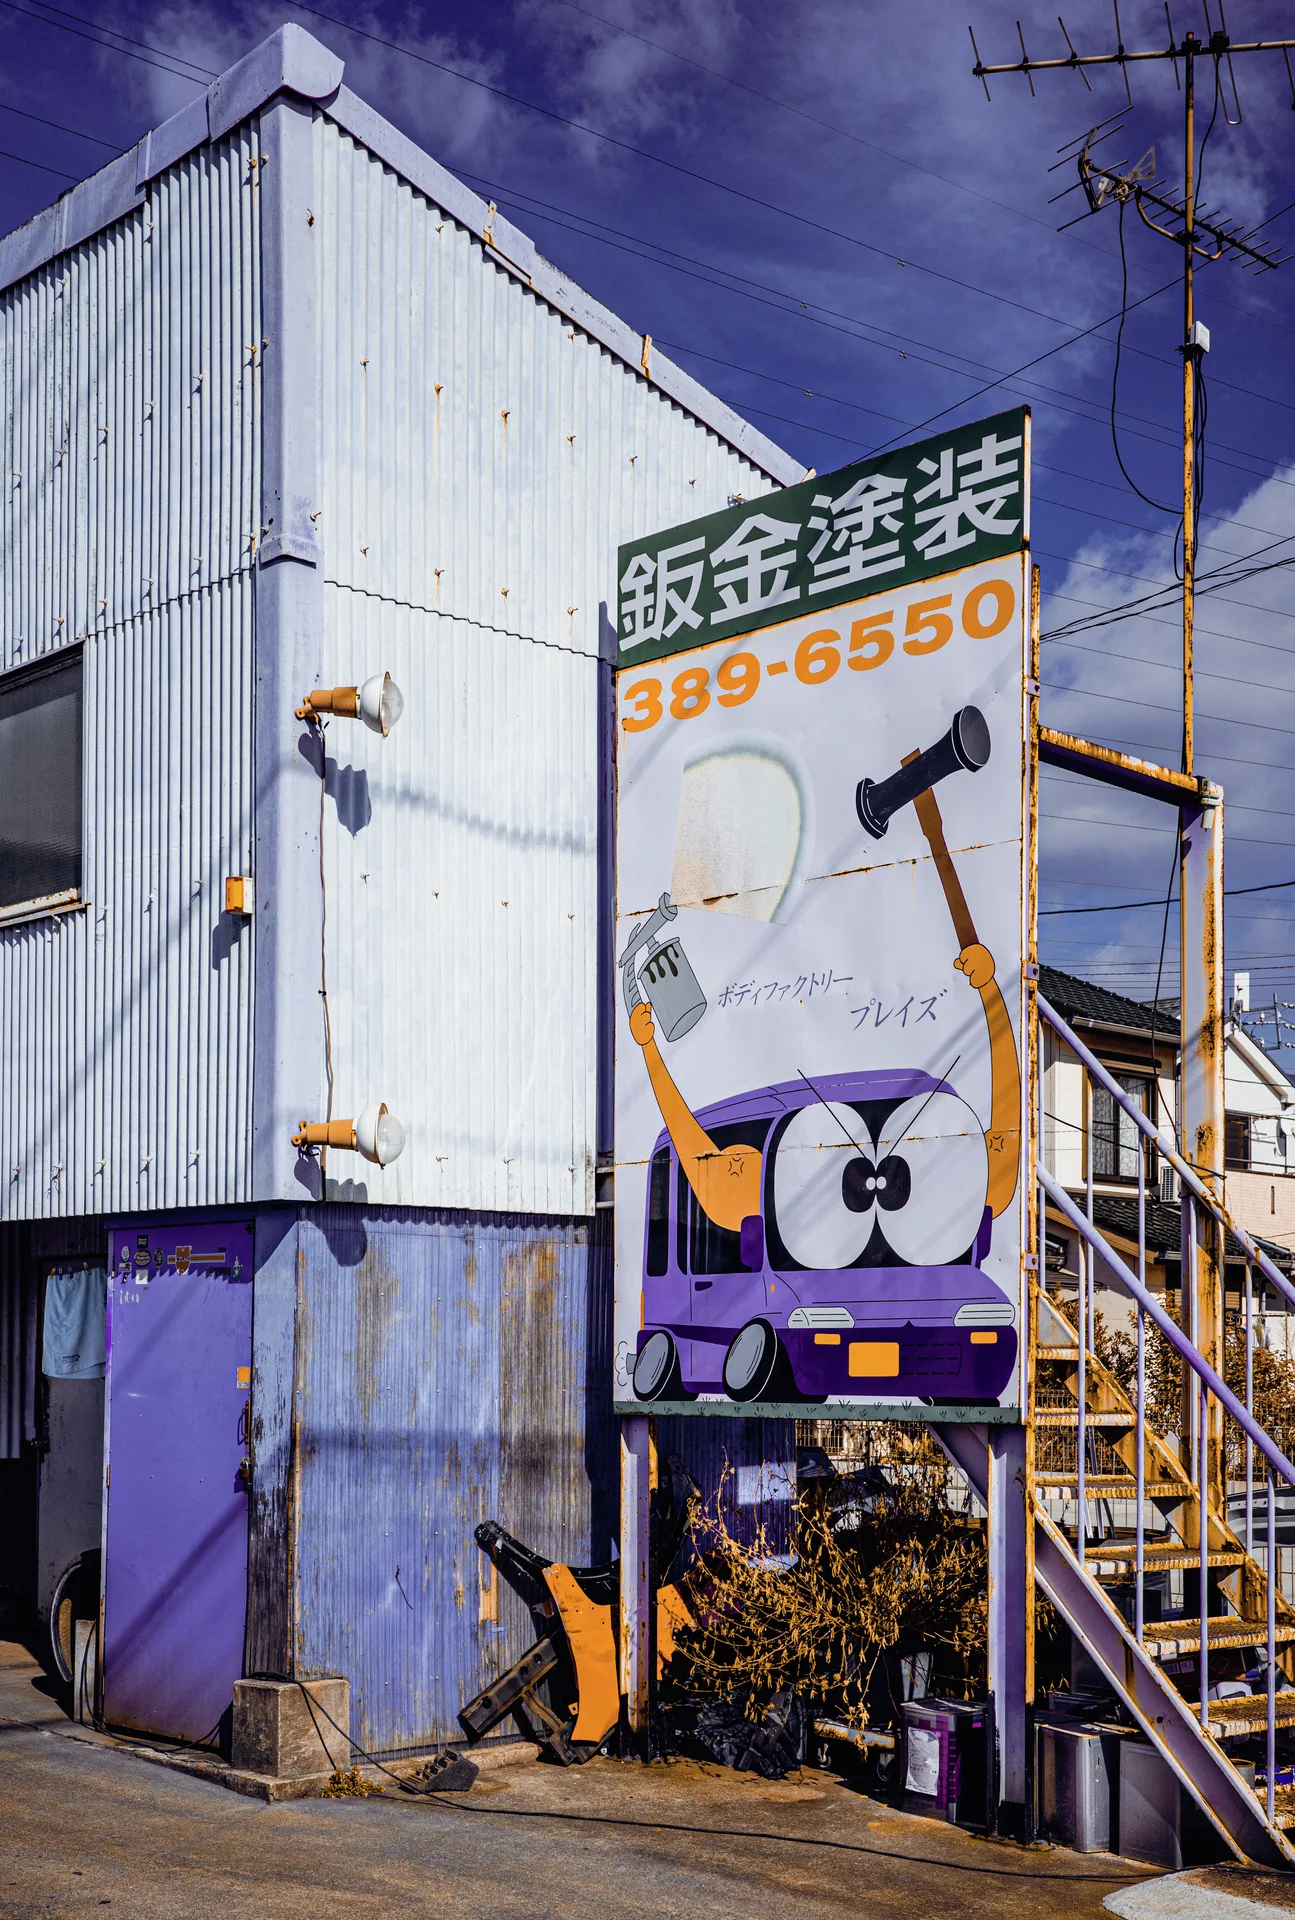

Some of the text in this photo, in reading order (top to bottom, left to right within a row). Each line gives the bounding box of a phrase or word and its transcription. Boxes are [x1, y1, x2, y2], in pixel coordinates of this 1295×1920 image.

[619, 433, 1022, 652] 鈑金塗装
[622, 579, 1016, 733] 389-6550
[717, 969, 854, 1007] ボディファクトリー
[850, 988, 949, 1031] プレイズ
